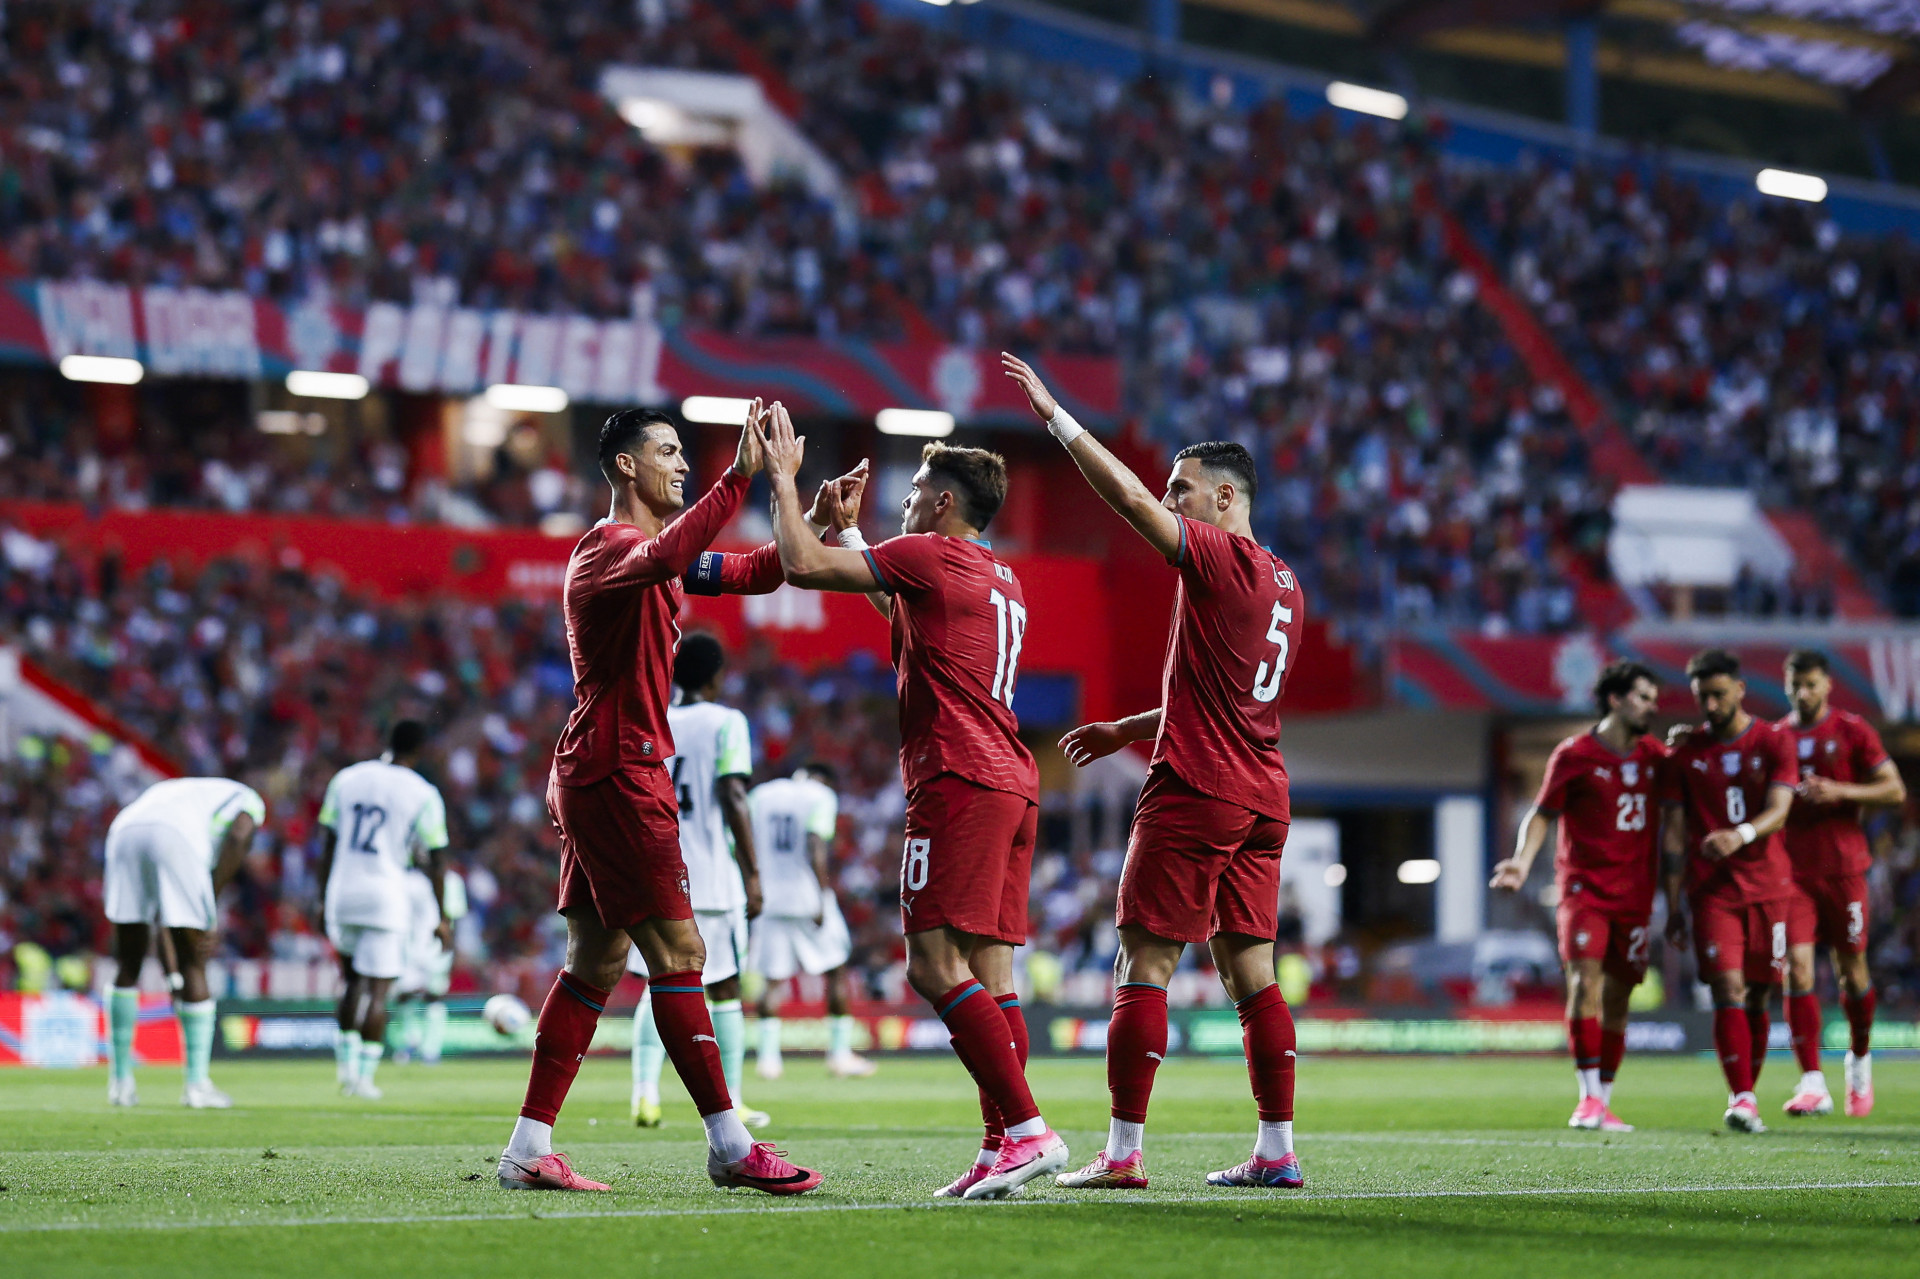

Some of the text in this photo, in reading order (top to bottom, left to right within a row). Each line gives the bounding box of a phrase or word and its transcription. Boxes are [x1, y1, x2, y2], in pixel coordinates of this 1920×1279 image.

[1252, 600, 1293, 703] 5
[351, 803, 387, 855] 12
[1616, 793, 1646, 832] 23
